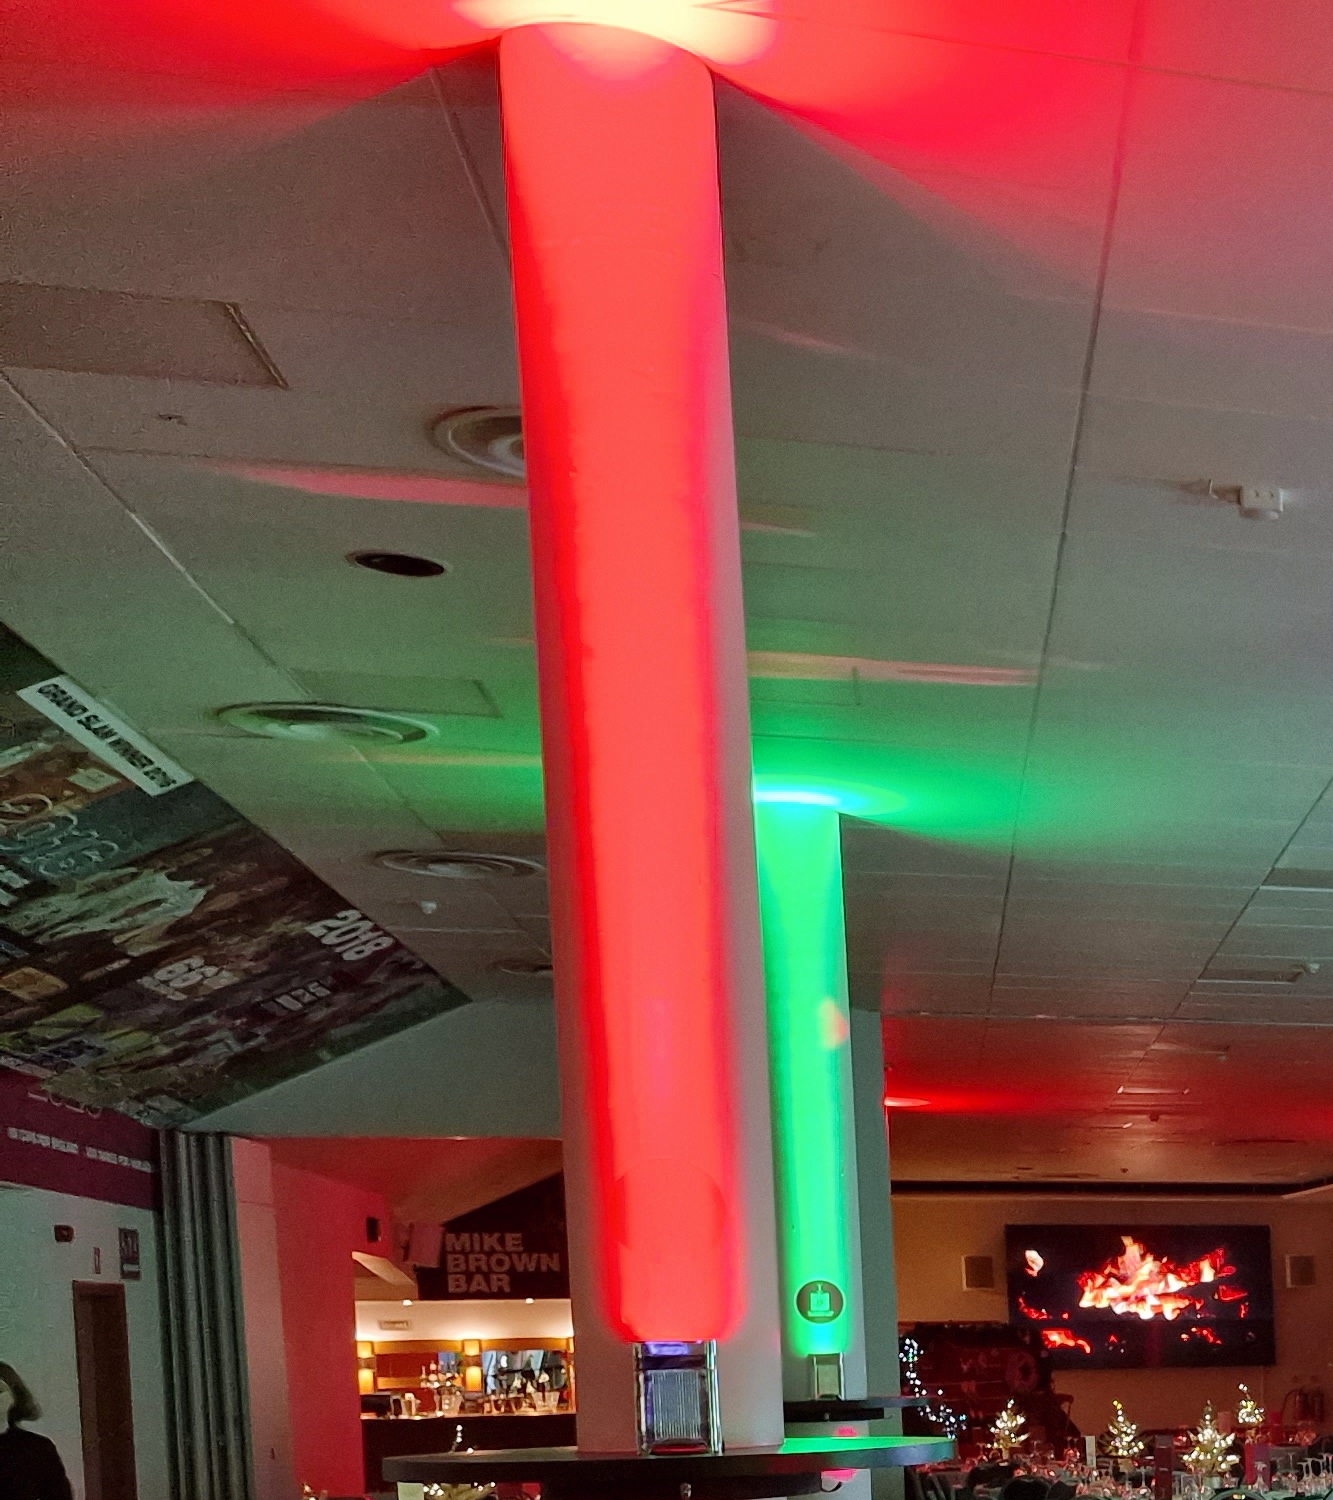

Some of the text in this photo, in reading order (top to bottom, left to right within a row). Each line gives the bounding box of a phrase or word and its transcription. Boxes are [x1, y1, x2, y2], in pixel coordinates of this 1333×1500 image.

[304, 909, 394, 961] 2018
[446, 1232, 523, 1252] MIKE
[447, 1252, 560, 1272] BROWN
[448, 1273, 511, 1293] BAR
